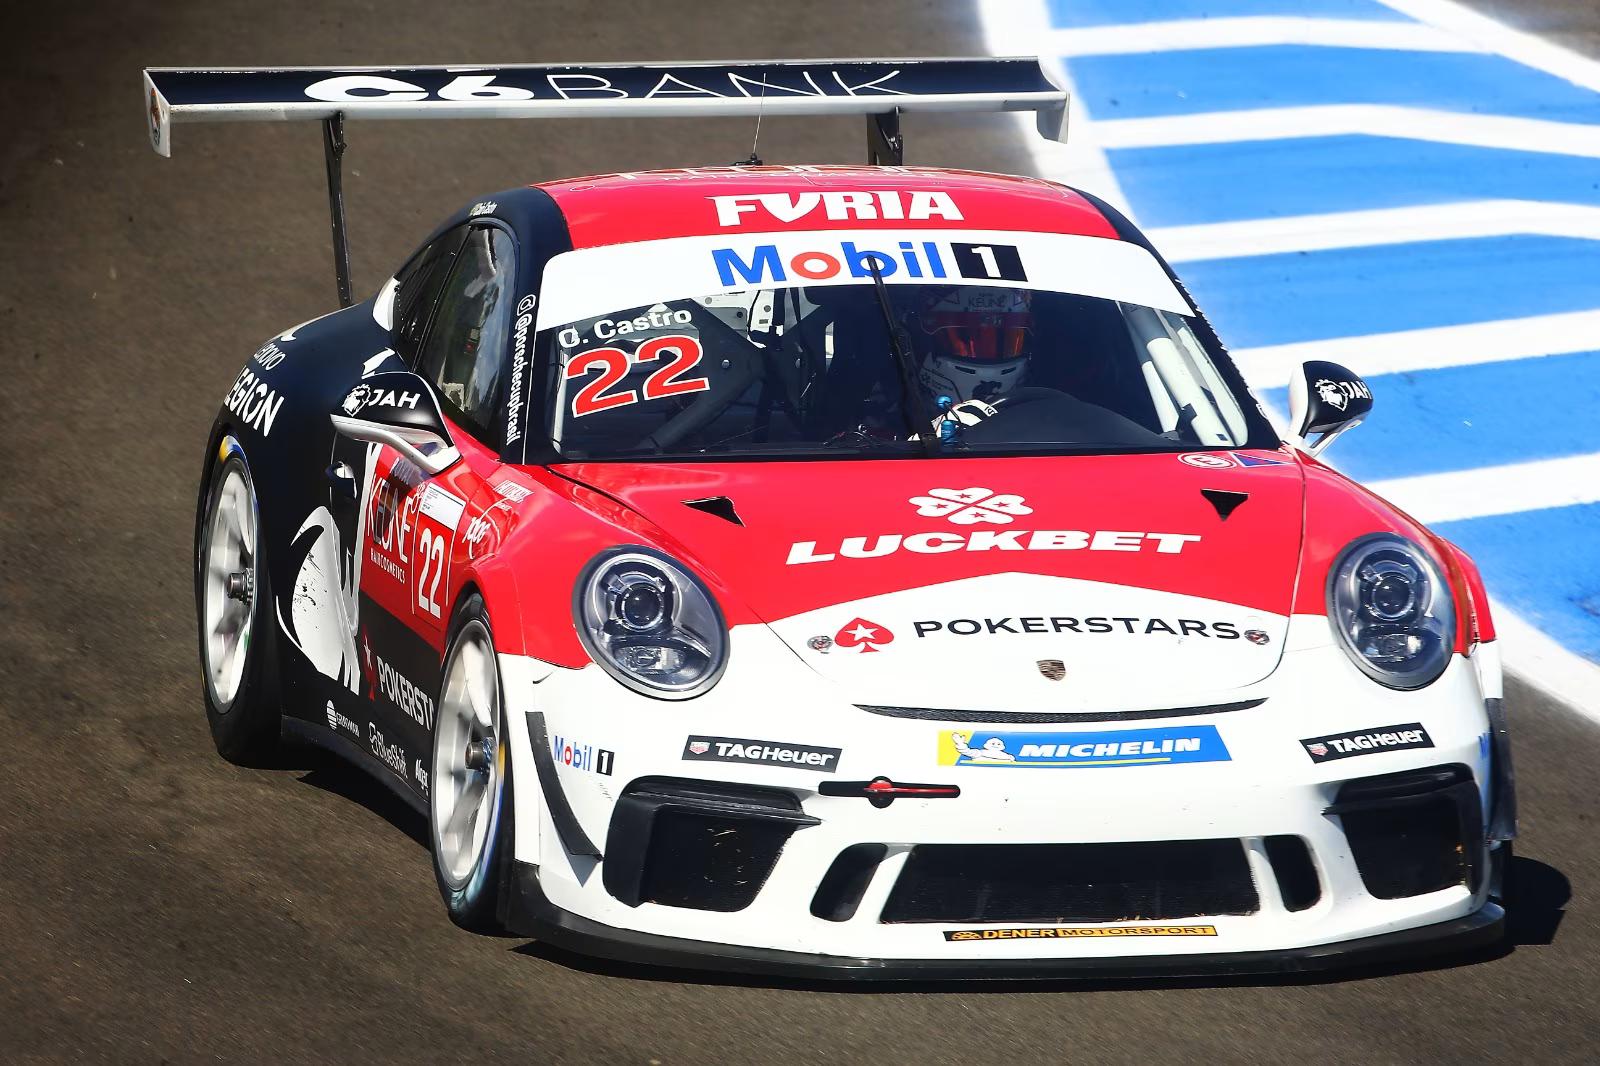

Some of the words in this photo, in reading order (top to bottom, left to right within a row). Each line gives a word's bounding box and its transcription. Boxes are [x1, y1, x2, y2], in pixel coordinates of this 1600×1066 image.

[304, 75, 535, 101] C6
[546, 70, 909, 99] BANK
[711, 241, 947, 286] Mobil
[593, 309, 692, 339] Castro
[563, 334, 711, 419] 22
[1342, 381, 1373, 400] JAH
[368, 389, 421, 410] JAH
[785, 530, 1201, 565] LUCKBET
[418, 528, 446, 619] 22
[913, 616, 1240, 640] POKERSTARS
[554, 735, 592, 772] Mobil
[1018, 737, 1200, 758] MICHELIN
[982, 929, 1056, 939] DENER
[1059, 926, 1211, 937] MOTORSPORT
